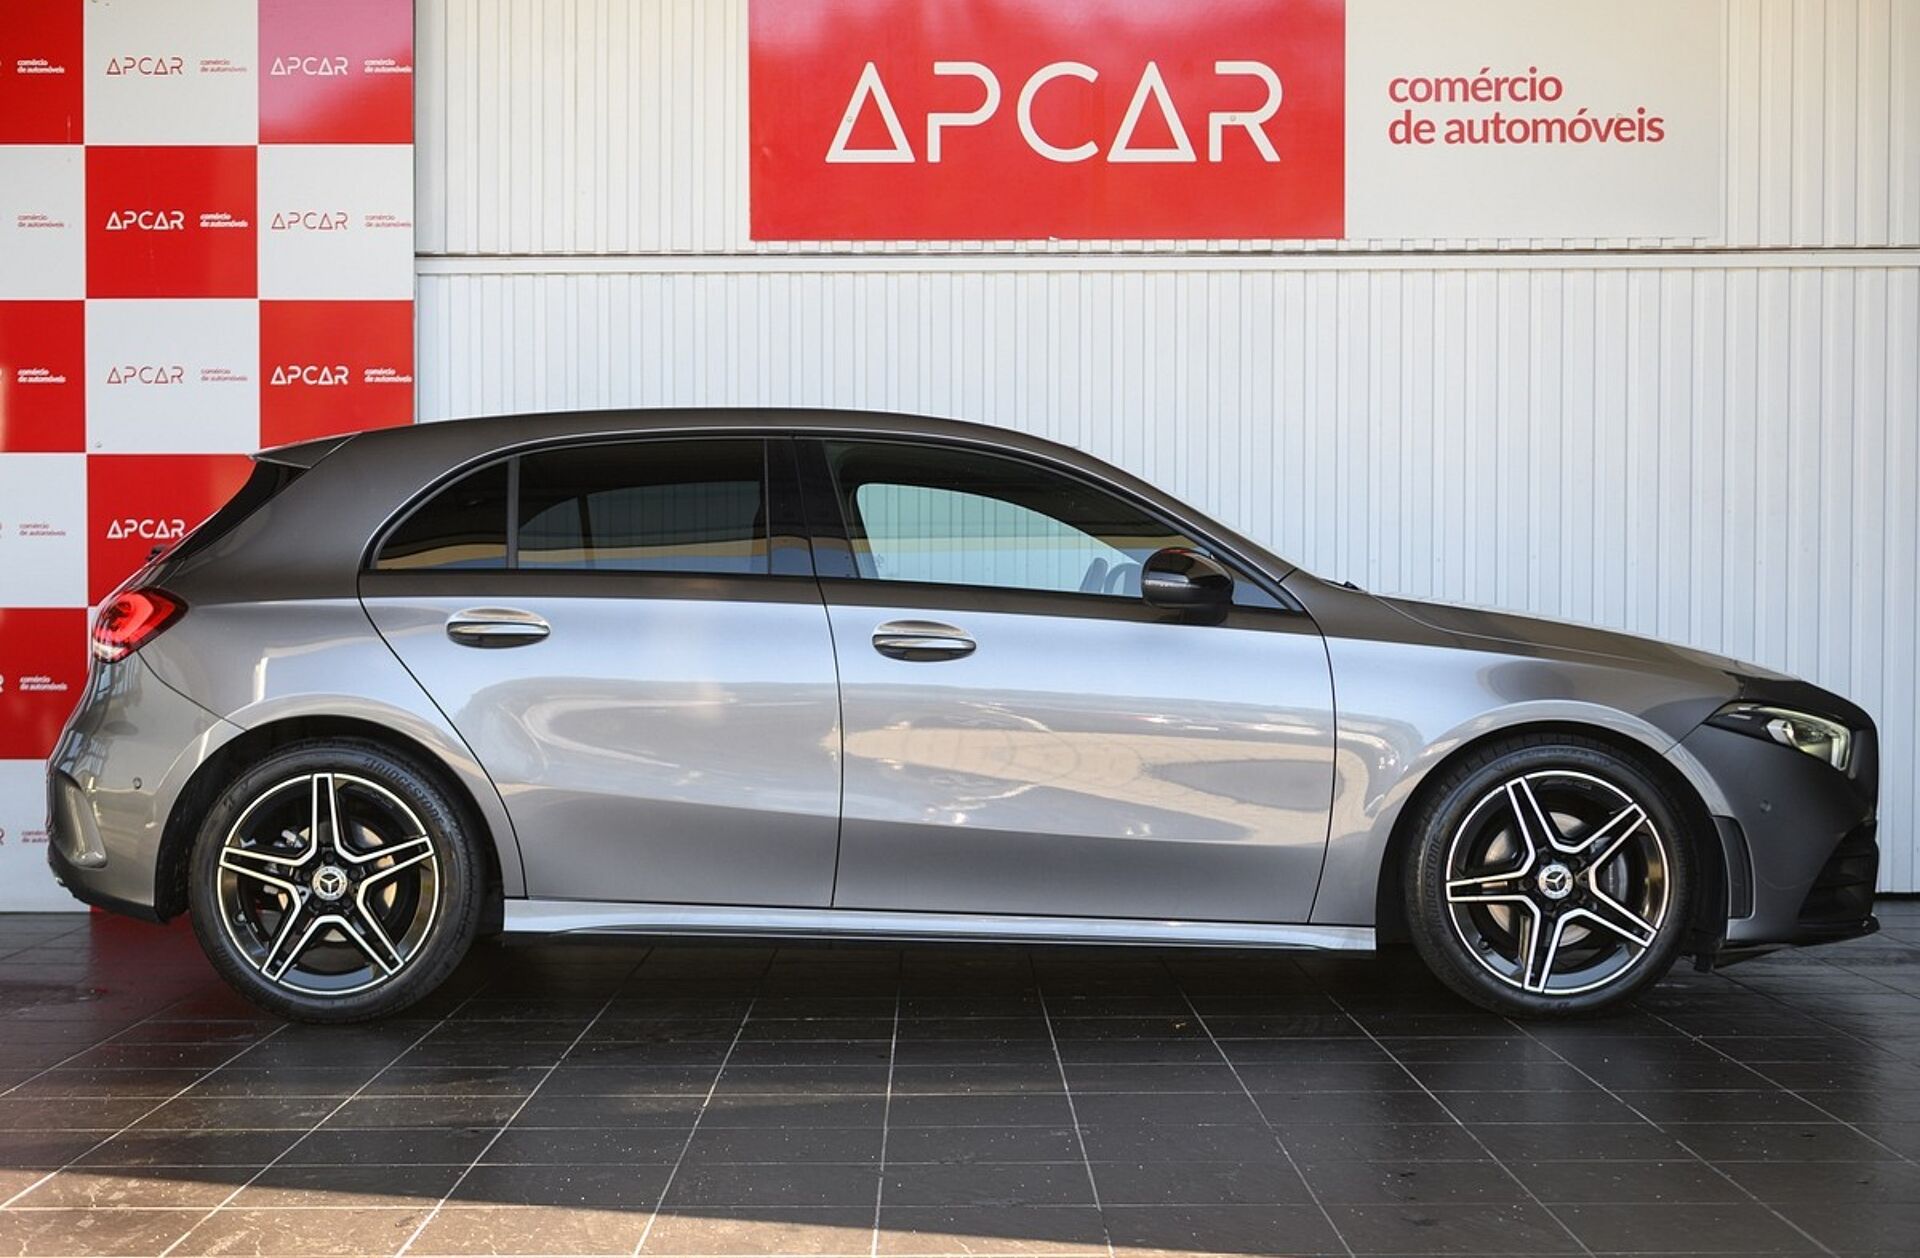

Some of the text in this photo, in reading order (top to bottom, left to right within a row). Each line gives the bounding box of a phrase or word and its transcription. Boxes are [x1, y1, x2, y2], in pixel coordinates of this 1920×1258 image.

[106, 56, 183, 75] APCAR
[270, 56, 348, 75] APCAR
[1388, 65, 1563, 103] comércio
[824, 61, 1284, 164] APCAR
[1388, 107, 1665, 144] de automóveis
[105, 210, 184, 230] APCAR
[271, 211, 348, 230] APCAR
[107, 366, 184, 384] APCAR
[270, 366, 348, 385] APCAR
[107, 519, 185, 539] APCAR
